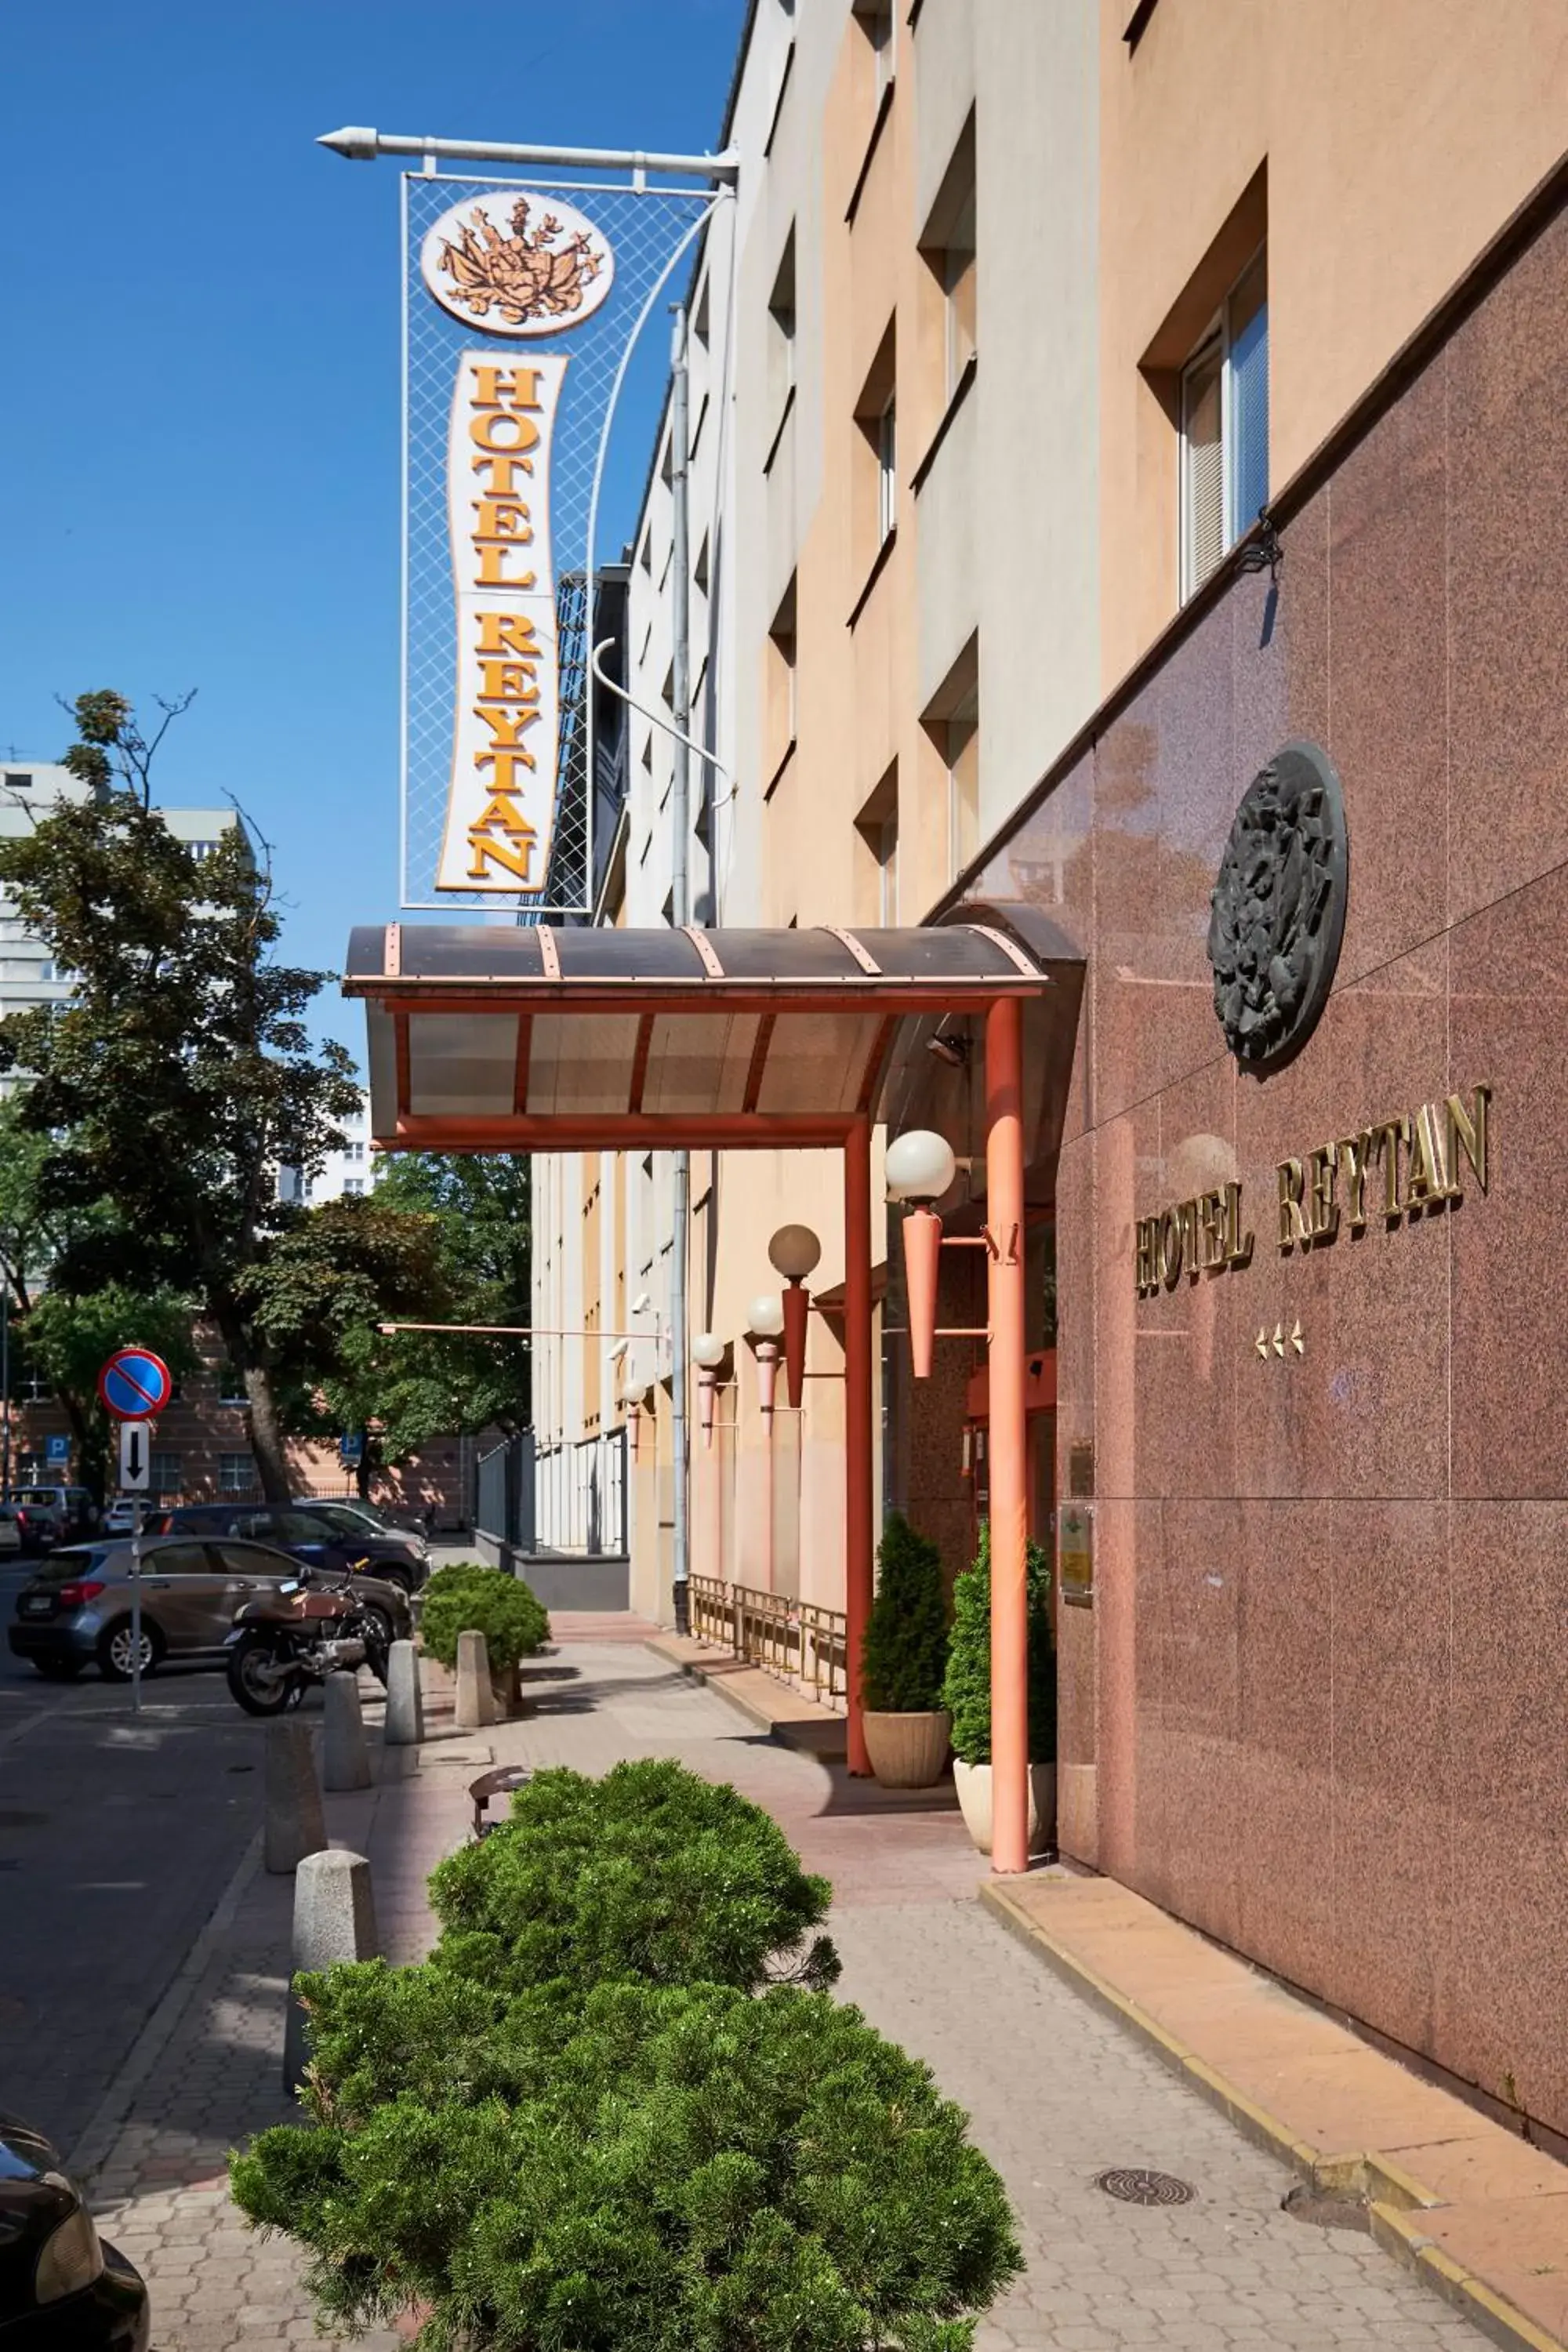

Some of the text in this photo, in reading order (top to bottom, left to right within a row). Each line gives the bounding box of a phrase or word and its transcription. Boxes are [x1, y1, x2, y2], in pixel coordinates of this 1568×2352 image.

[469, 365, 543, 587] HOTEL
[466, 612, 542, 879] REYTAN
[1134, 1080, 1492, 1292] HOTEL REYTAN
[53, 1439, 64, 1455] P
